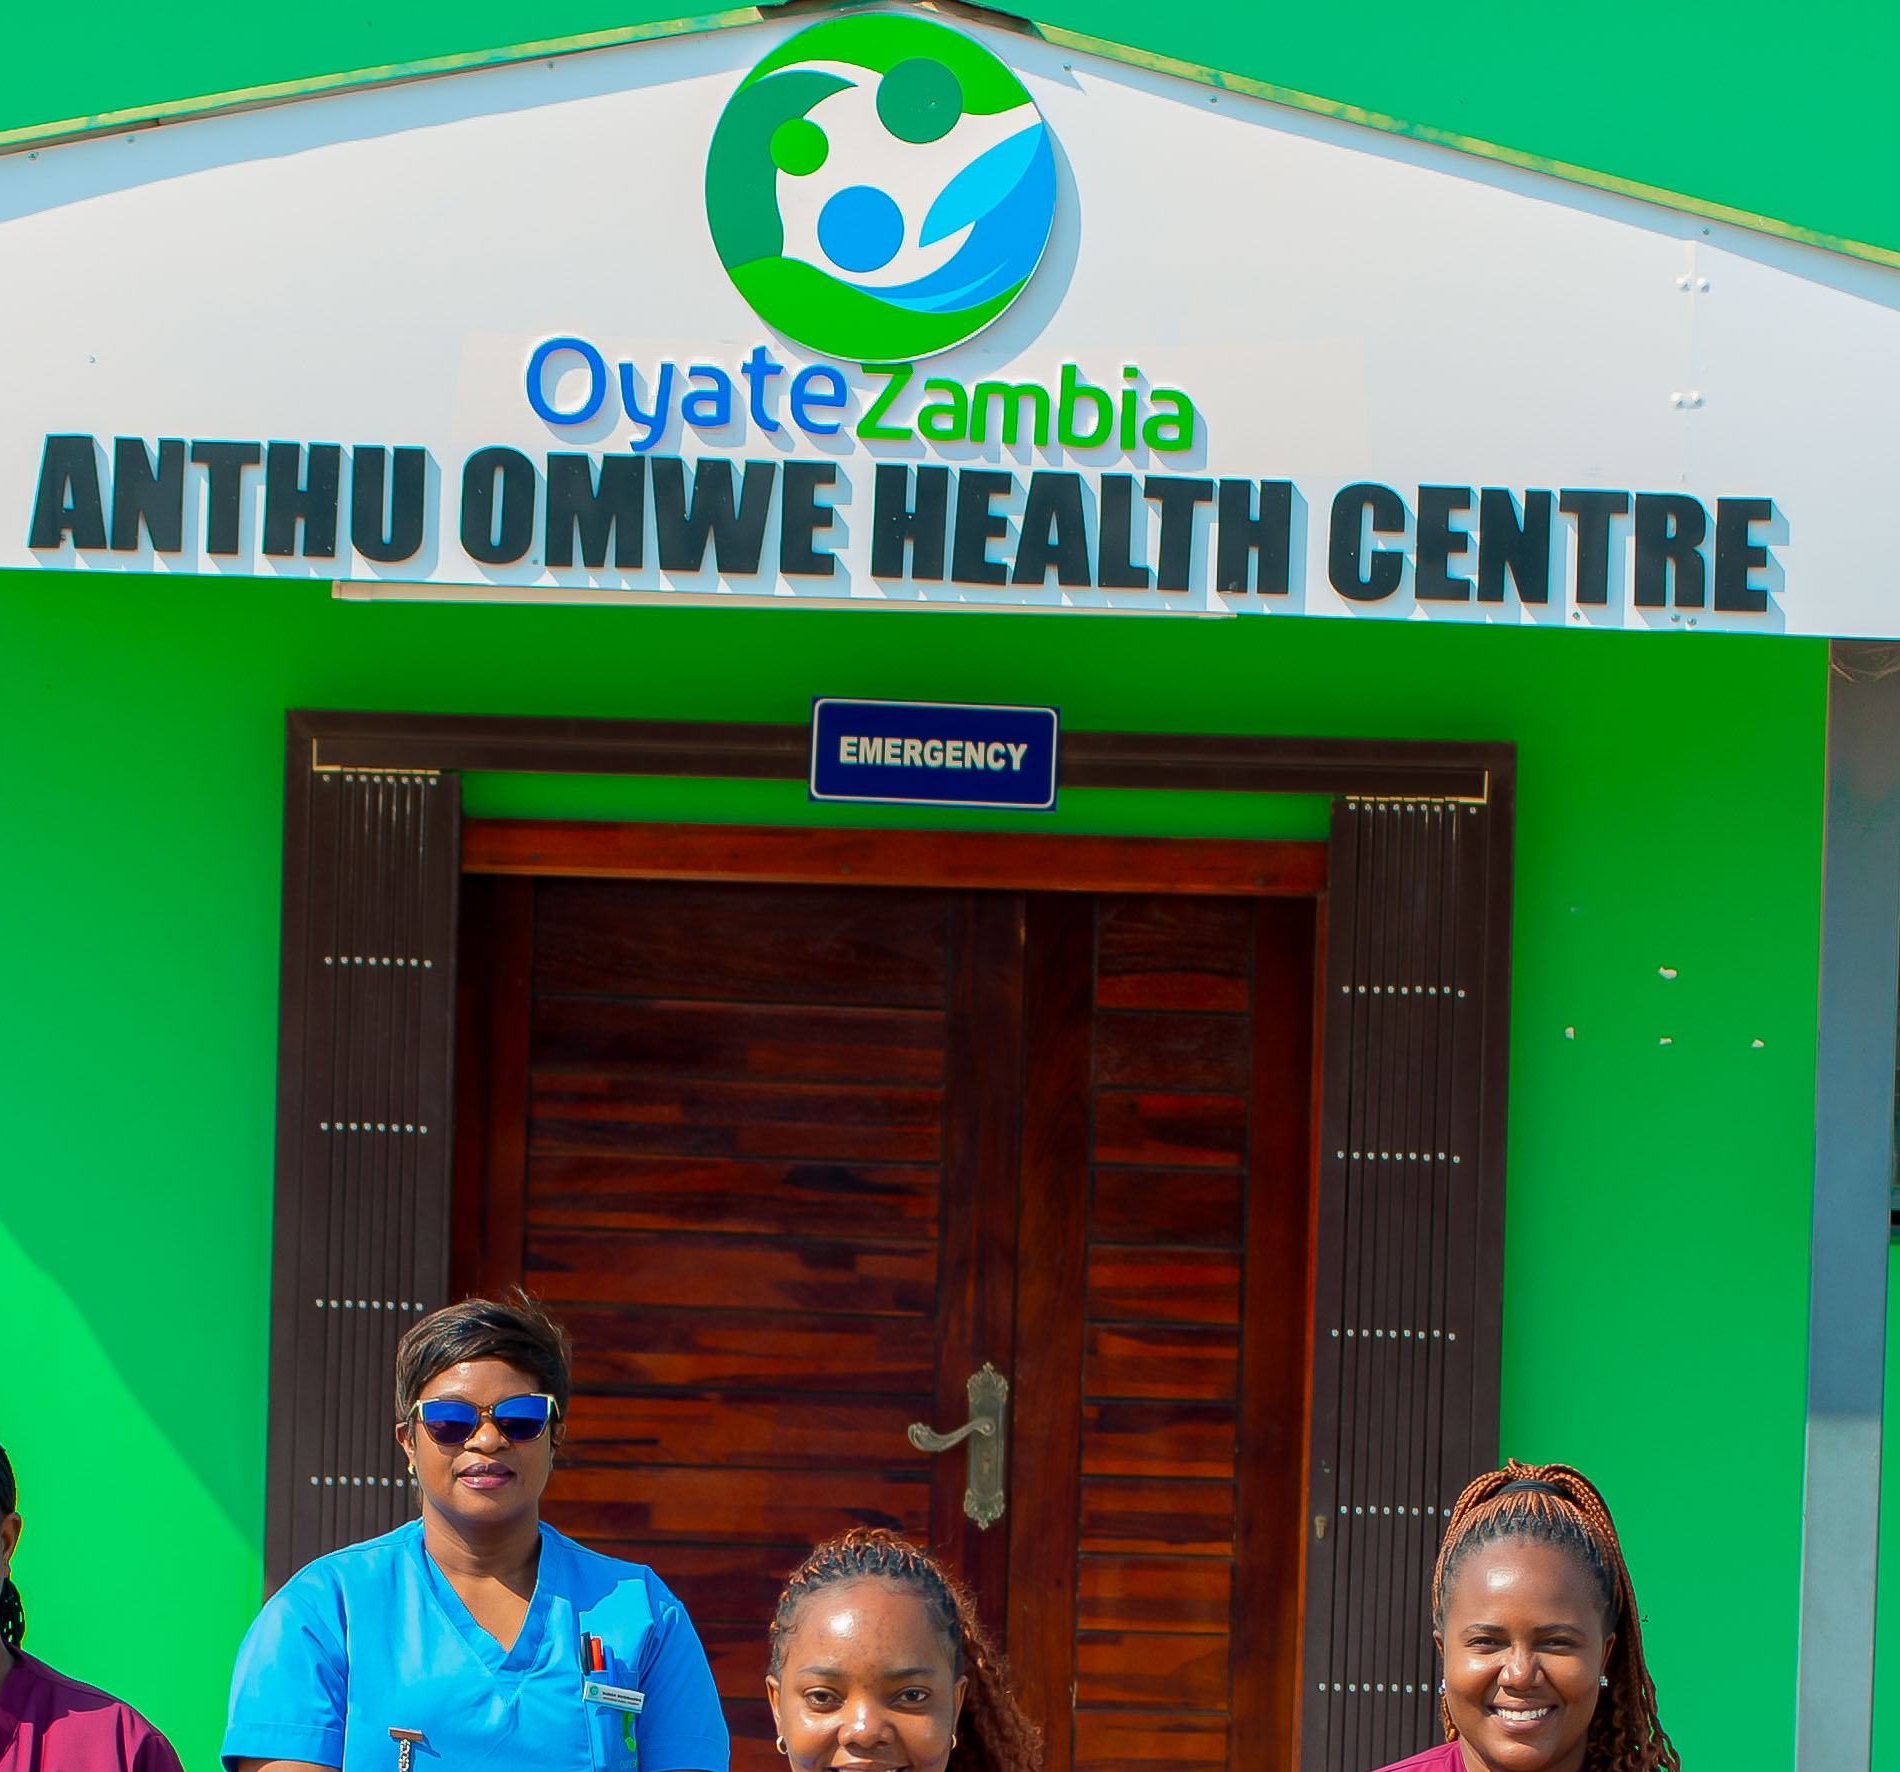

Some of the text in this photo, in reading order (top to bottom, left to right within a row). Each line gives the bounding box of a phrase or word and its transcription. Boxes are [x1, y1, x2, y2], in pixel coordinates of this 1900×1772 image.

[27, 433, 1774, 614] ANTHU OMWE HEALTH CENTRE
[839, 735, 1029, 772] EMERGENCY
